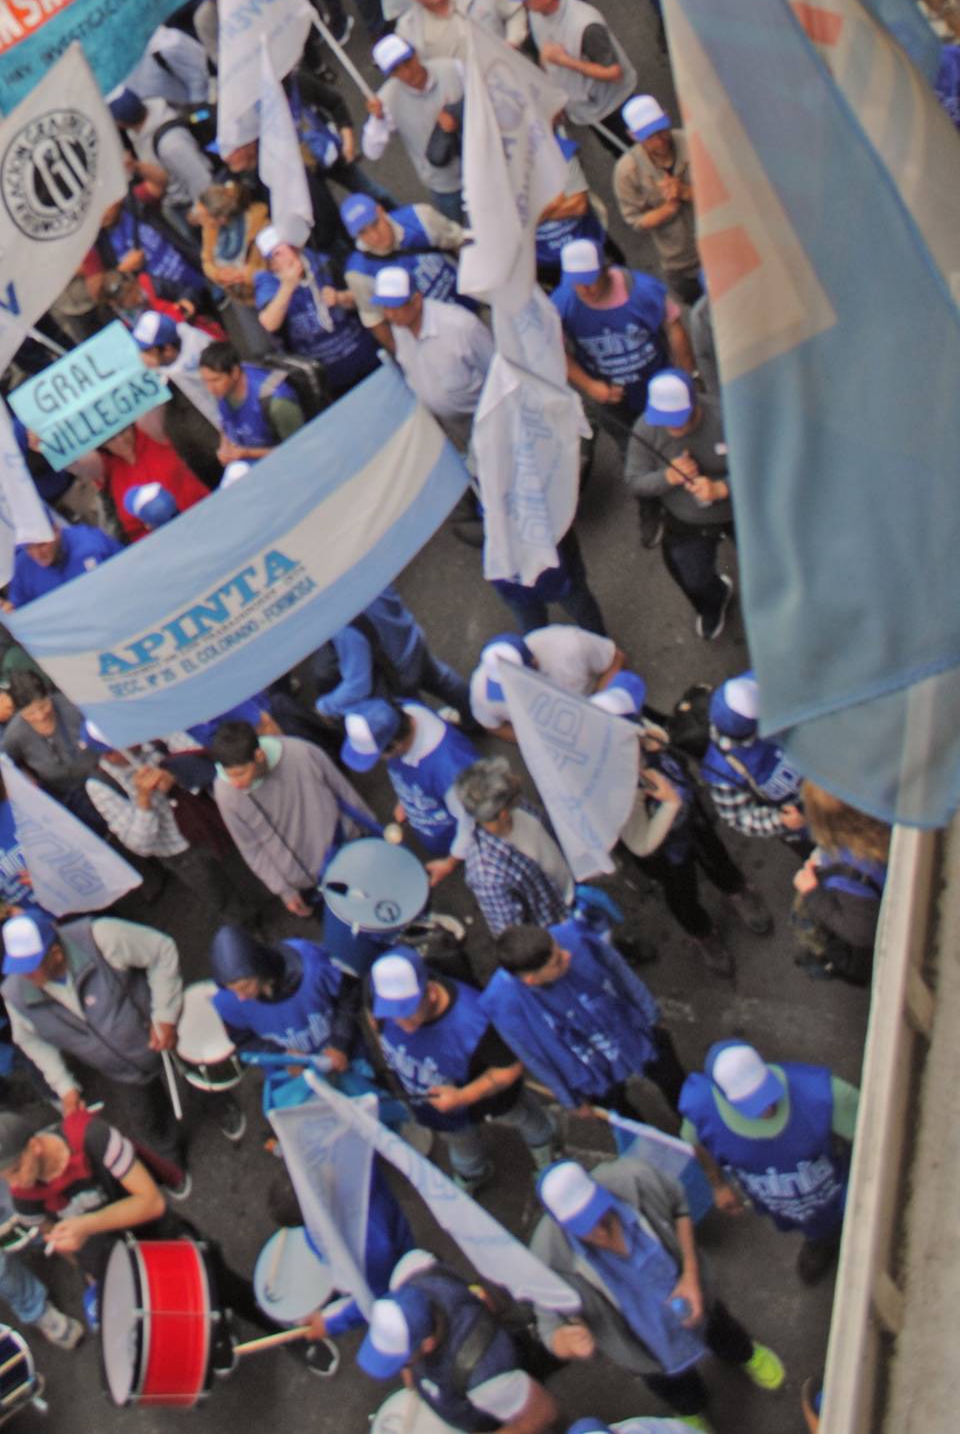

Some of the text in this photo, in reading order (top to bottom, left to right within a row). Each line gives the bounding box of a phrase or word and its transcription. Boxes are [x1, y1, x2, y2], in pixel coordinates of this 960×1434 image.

[32, 352, 117, 415] GRAL
[39, 370, 163, 459] VILLEGAS
[98, 549, 301, 677] APINTA
[196, 619, 259, 666] COLORADO
